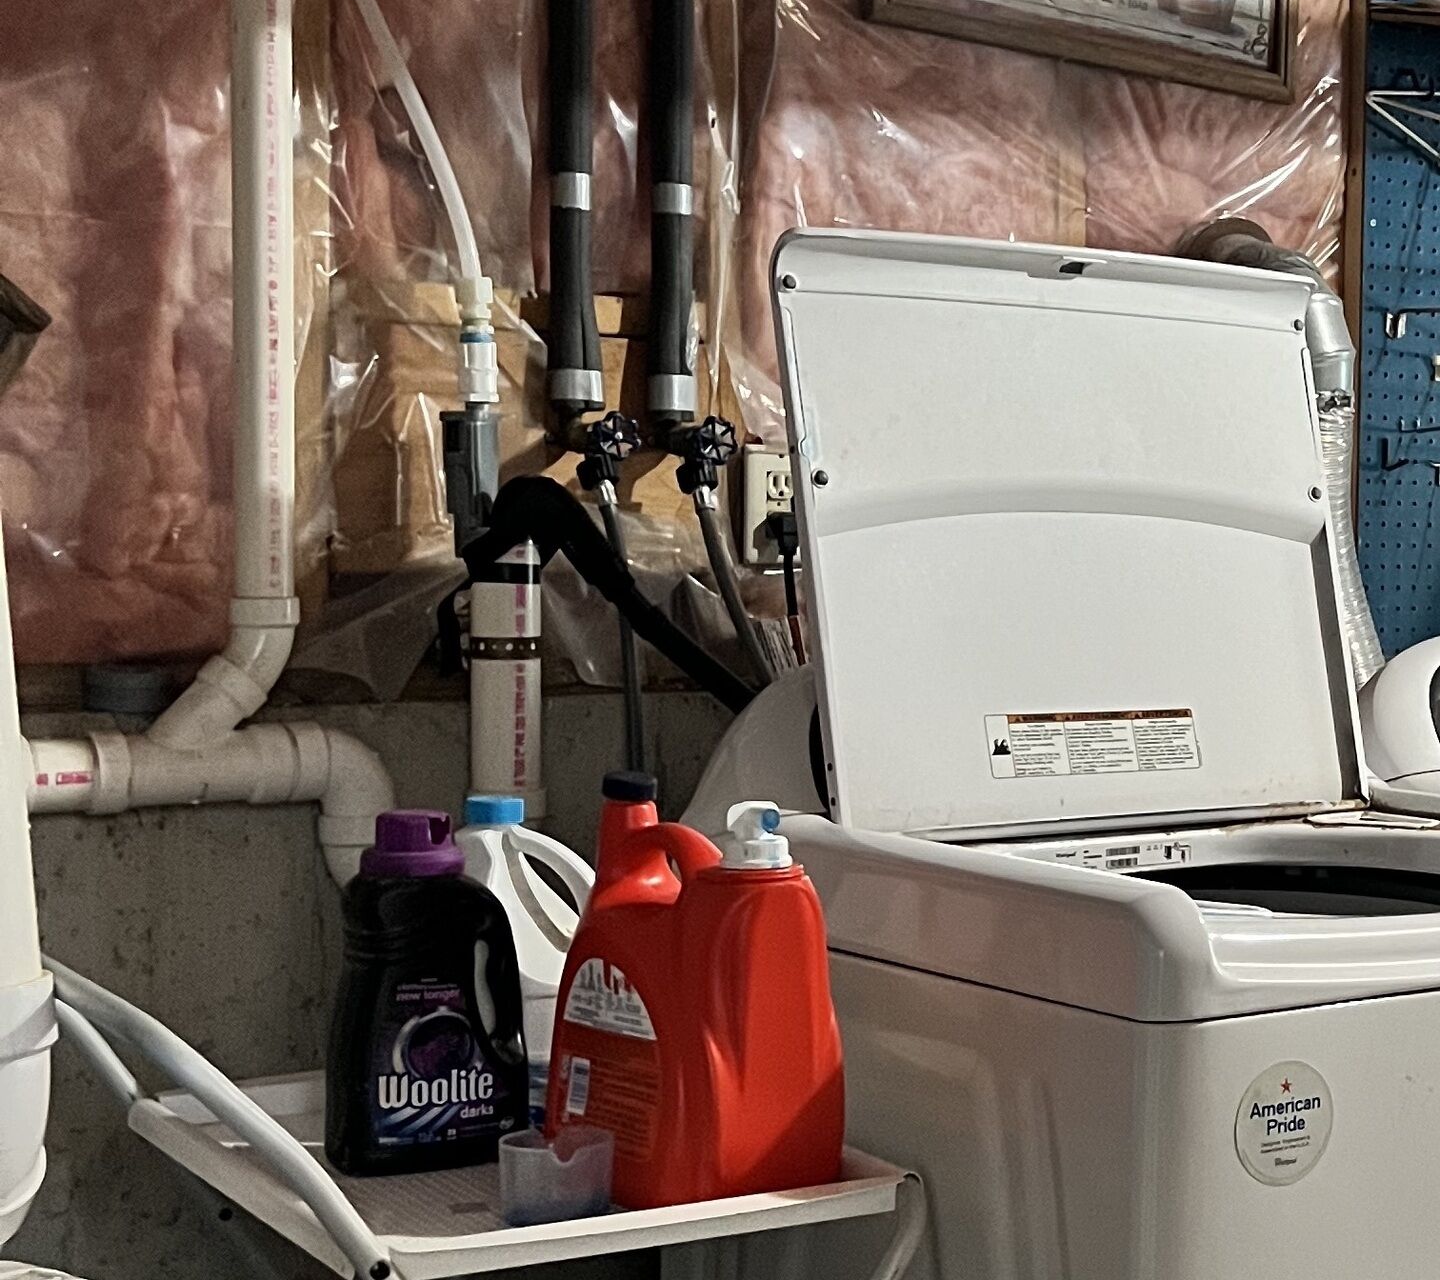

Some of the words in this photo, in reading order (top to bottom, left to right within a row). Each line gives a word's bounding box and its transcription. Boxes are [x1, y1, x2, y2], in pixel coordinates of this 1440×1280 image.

[378, 1068, 494, 1109] Woolite
[460, 1104, 494, 1119] darks
[1249, 1096, 1321, 1120] American
[1267, 1115, 1305, 1135] Pride
